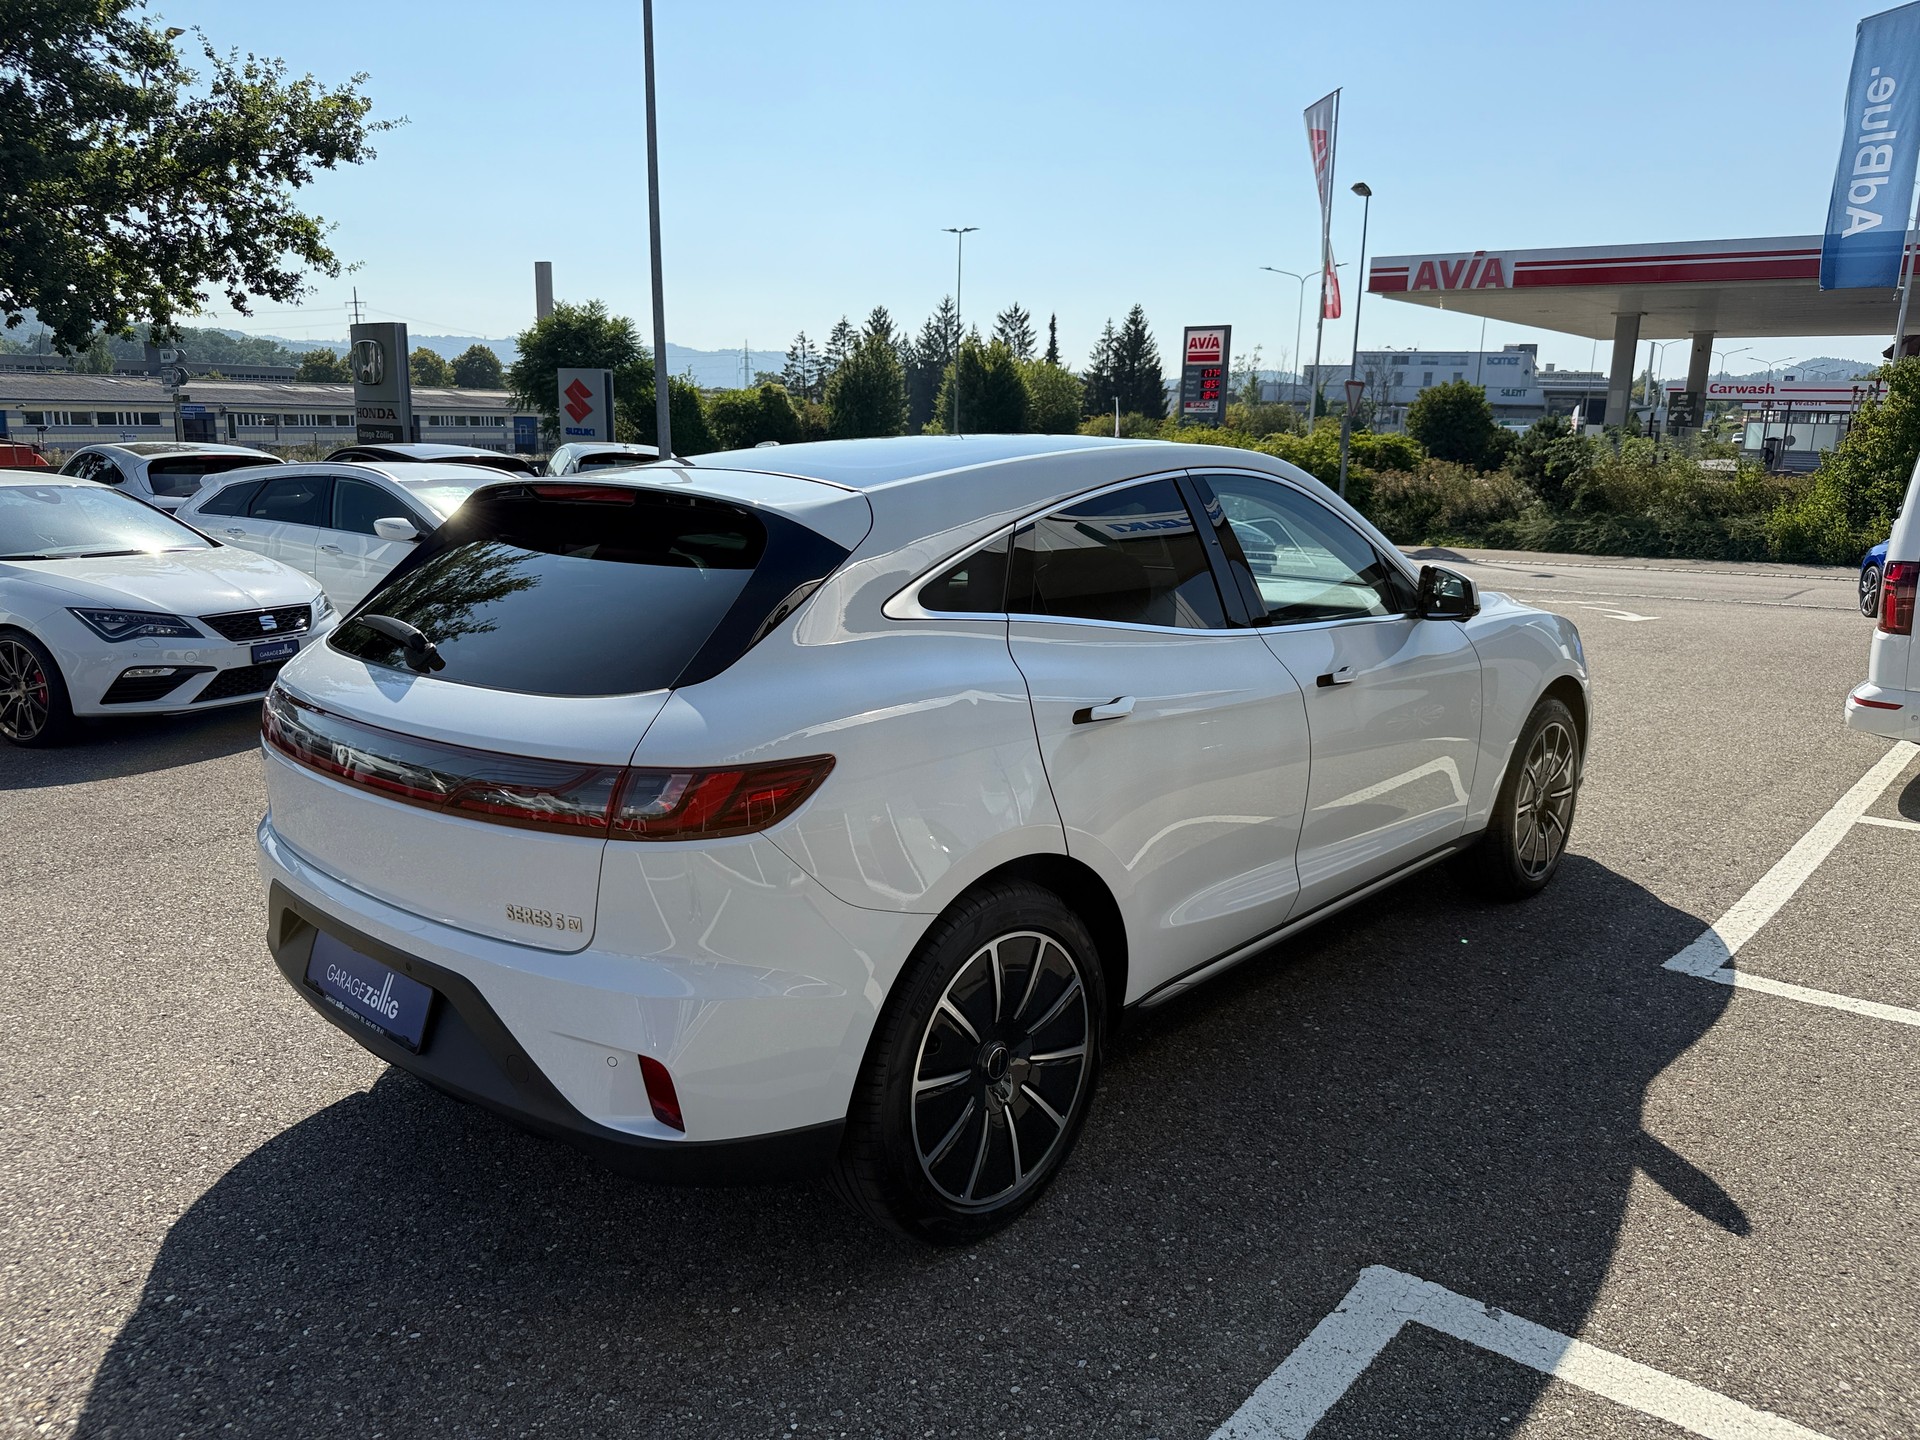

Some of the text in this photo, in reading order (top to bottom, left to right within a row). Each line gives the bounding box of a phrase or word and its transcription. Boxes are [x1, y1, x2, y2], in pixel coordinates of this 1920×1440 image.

[1411, 250, 1505, 290] AVIA
[1188, 334, 1220, 350] AVIA
[1500, 389, 1528, 397] SILENT
[1709, 382, 1775, 394] Carwash
[356, 407, 398, 420] HONDA
[565, 427, 595, 437] SUZUKI
[505, 903, 553, 929] SERES
[556, 912, 565, 931] 5
